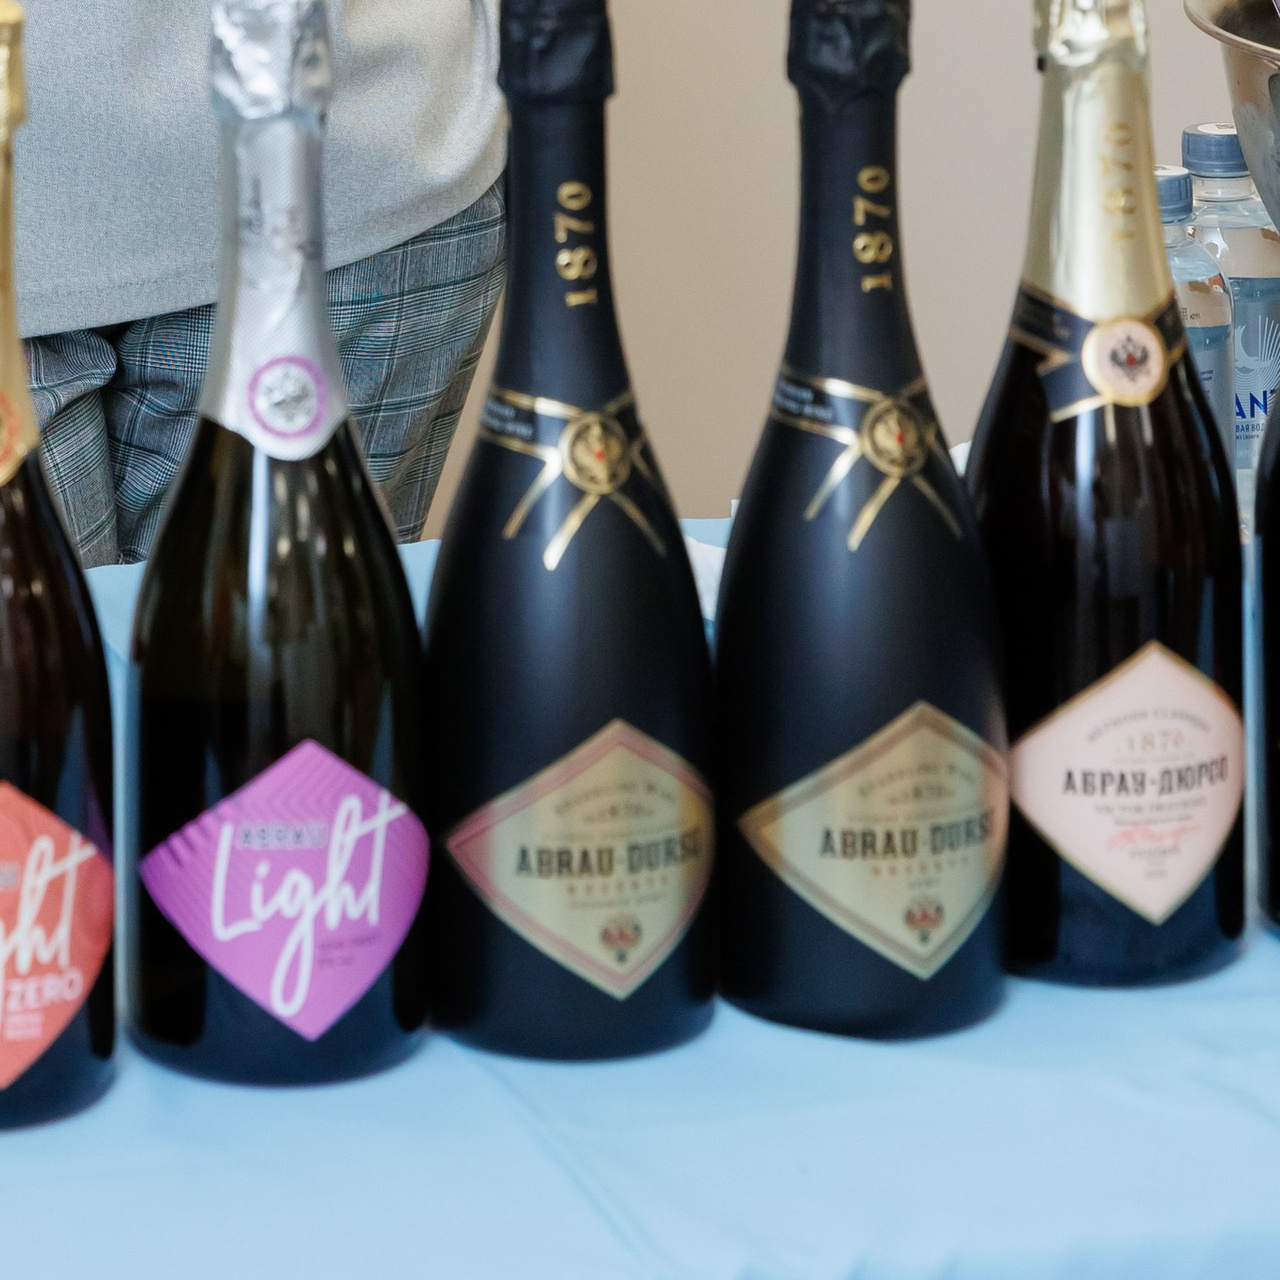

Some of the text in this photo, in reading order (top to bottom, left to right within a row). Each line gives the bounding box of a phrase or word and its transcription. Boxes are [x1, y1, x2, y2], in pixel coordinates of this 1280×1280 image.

[553, 180, 598, 307] 1870
[852, 165, 893, 293] 1870
[211, 789, 408, 1018] Light
[6, 967, 84, 1011] ZERO
